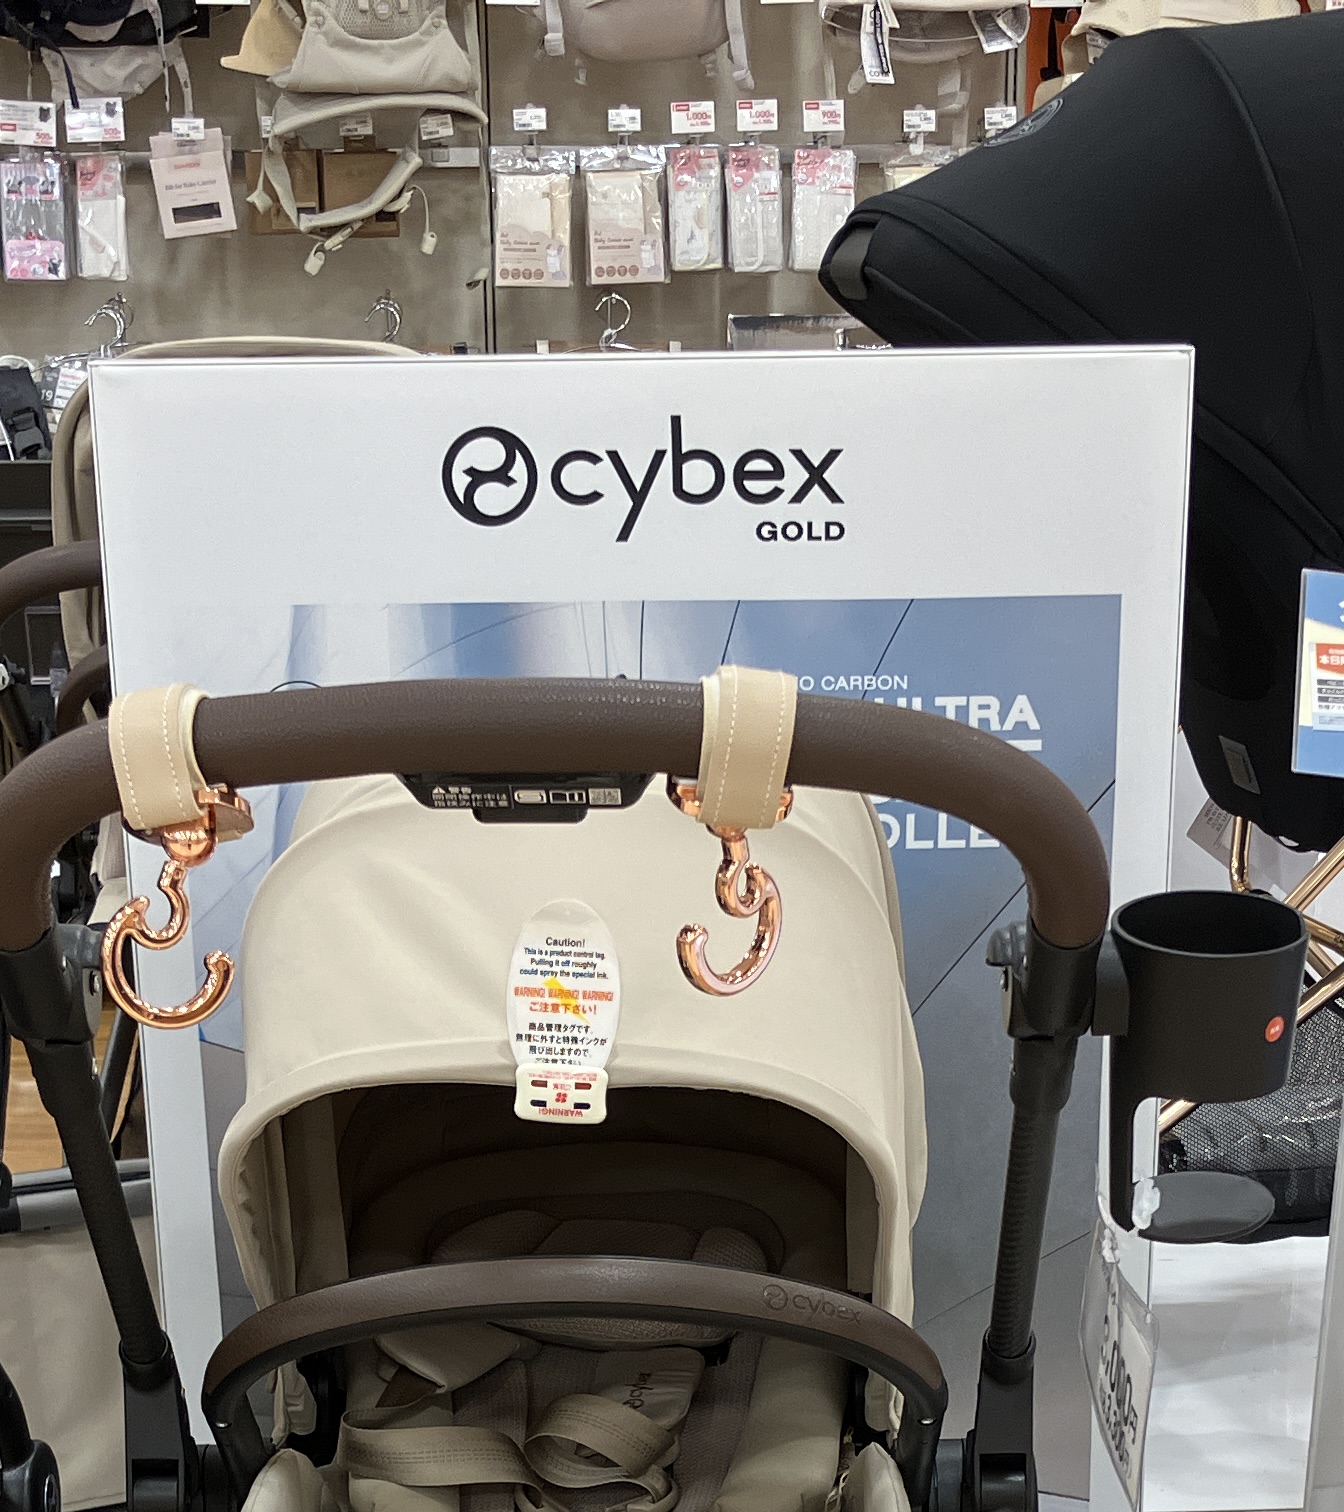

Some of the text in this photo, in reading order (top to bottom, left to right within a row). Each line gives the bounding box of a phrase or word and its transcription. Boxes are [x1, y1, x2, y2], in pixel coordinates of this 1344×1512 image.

[552, 415, 844, 543] cybex
[756, 520, 846, 542] GOLD
[821, 674, 908, 692] CARBON
[545, 936, 586, 949] Caution!
[550, 949, 573, 958] product
[531, 957, 554, 968] Pulling
[572, 961, 597, 970] roughly
[520, 968, 596, 979] could spray the special
[528, 1001, 597, 1015] ご注意下さい!
[528, 1022, 594, 1035] 商品管理タグです。
[538, 1107, 584, 1118] WARNING!
[792, 1292, 862, 1326] cybex
